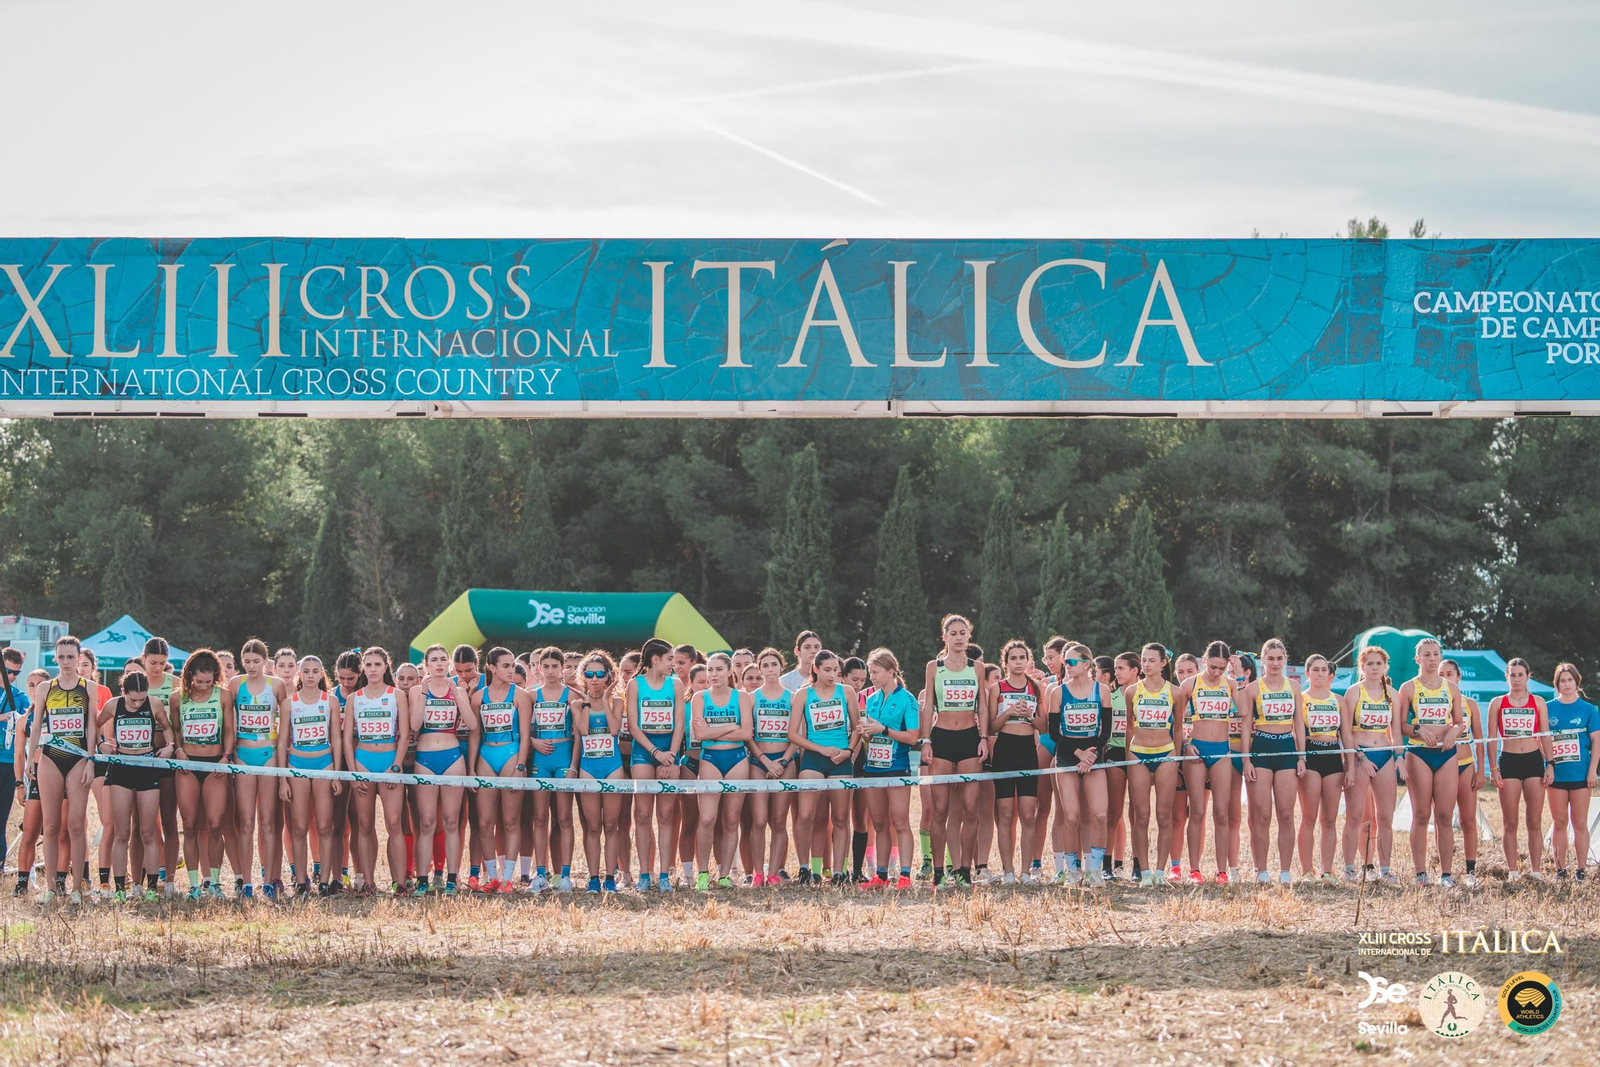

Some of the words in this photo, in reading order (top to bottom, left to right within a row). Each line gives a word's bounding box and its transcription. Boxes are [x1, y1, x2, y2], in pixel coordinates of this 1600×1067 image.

[642, 239, 1214, 369] ITÁLICA
[0, 263, 291, 358] XLIII
[300, 265, 531, 320] CROSS
[1481, 317, 1517, 338] DE
[300, 329, 619, 358] INTERNACIONAL
[1546, 342, 1600, 364] POR
[282, 368, 386, 396] CROSS
[396, 368, 561, 396] COUNTRY
[567, 605, 606, 614] Diputación
[567, 613, 606, 624] Sevilla
[946, 690, 974, 700] 5534
[760, 701, 785, 709] nerja
[1200, 701, 1229, 712] 7540
[1266, 703, 1293, 714] 7542
[427, 711, 454, 721] 7531
[537, 712, 563, 723] 7557
[643, 711, 671, 722] 7554
[814, 709, 842, 723] 7547
[1068, 713, 1096, 724] 5558
[1140, 710, 1167, 721] 7544
[1421, 708, 1447, 718] 7543
[52, 718, 82, 730] 5568
[241, 715, 269, 726] 5540
[484, 713, 511, 725] 7560
[1311, 715, 1339, 725] 7539
[1364, 714, 1389, 724] 7541
[1505, 718, 1532, 728] 5556
[187, 723, 215, 735] 7567
[361, 722, 390, 733] 5539
[760, 720, 787, 731] 7552
[120, 730, 149, 741] 5570
[298, 726, 326, 739] 7535
[1260, 731, 1277, 740] PRO
[585, 738, 612, 750] 5579
[1552, 743, 1578, 756] 5559
[870, 747, 890, 760] 7553
